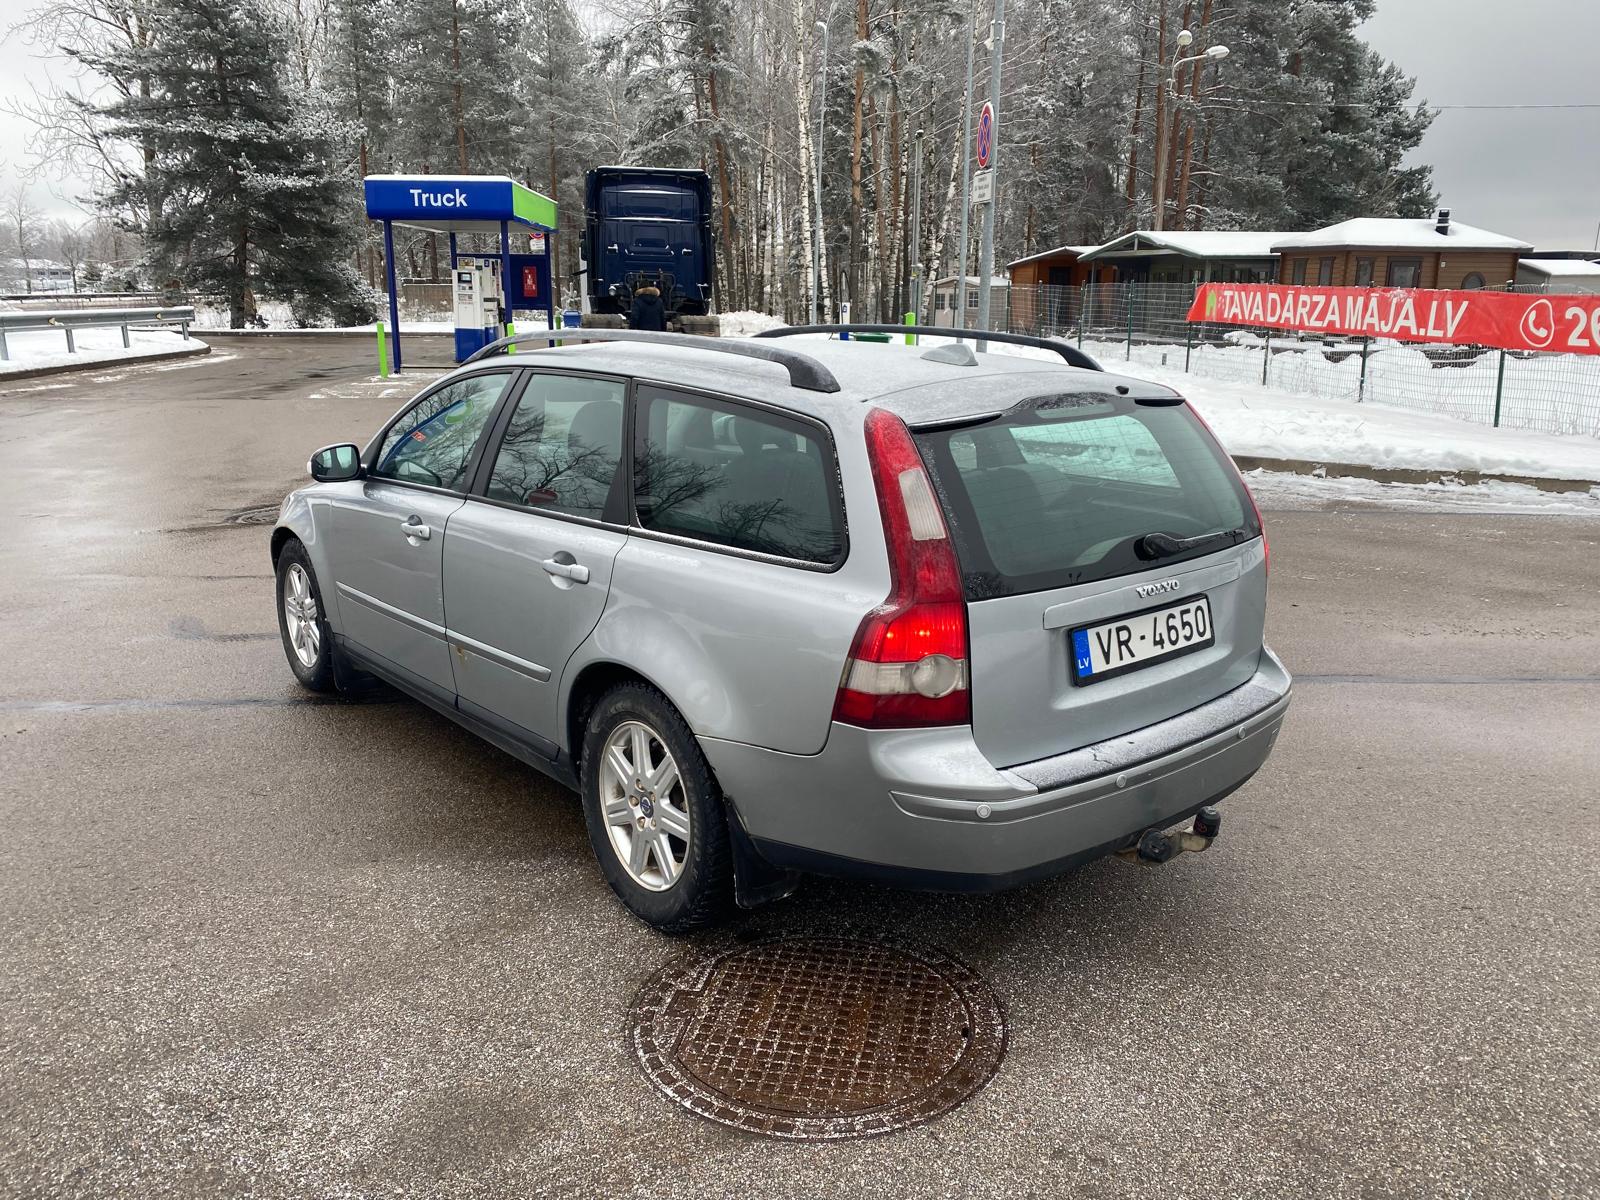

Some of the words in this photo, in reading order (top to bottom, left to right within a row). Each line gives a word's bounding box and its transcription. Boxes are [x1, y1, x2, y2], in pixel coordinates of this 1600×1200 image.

[409, 188, 468, 207] Truck
[1223, 290, 1264, 321] TAVA
[1266, 290, 1341, 328] DĀRZA
[1344, 293, 1469, 338] MĀJA.LV
[1136, 579, 1180, 598] VOLVO
[1095, 605, 1207, 665] VR-4650
[1078, 656, 1090, 669] LV
